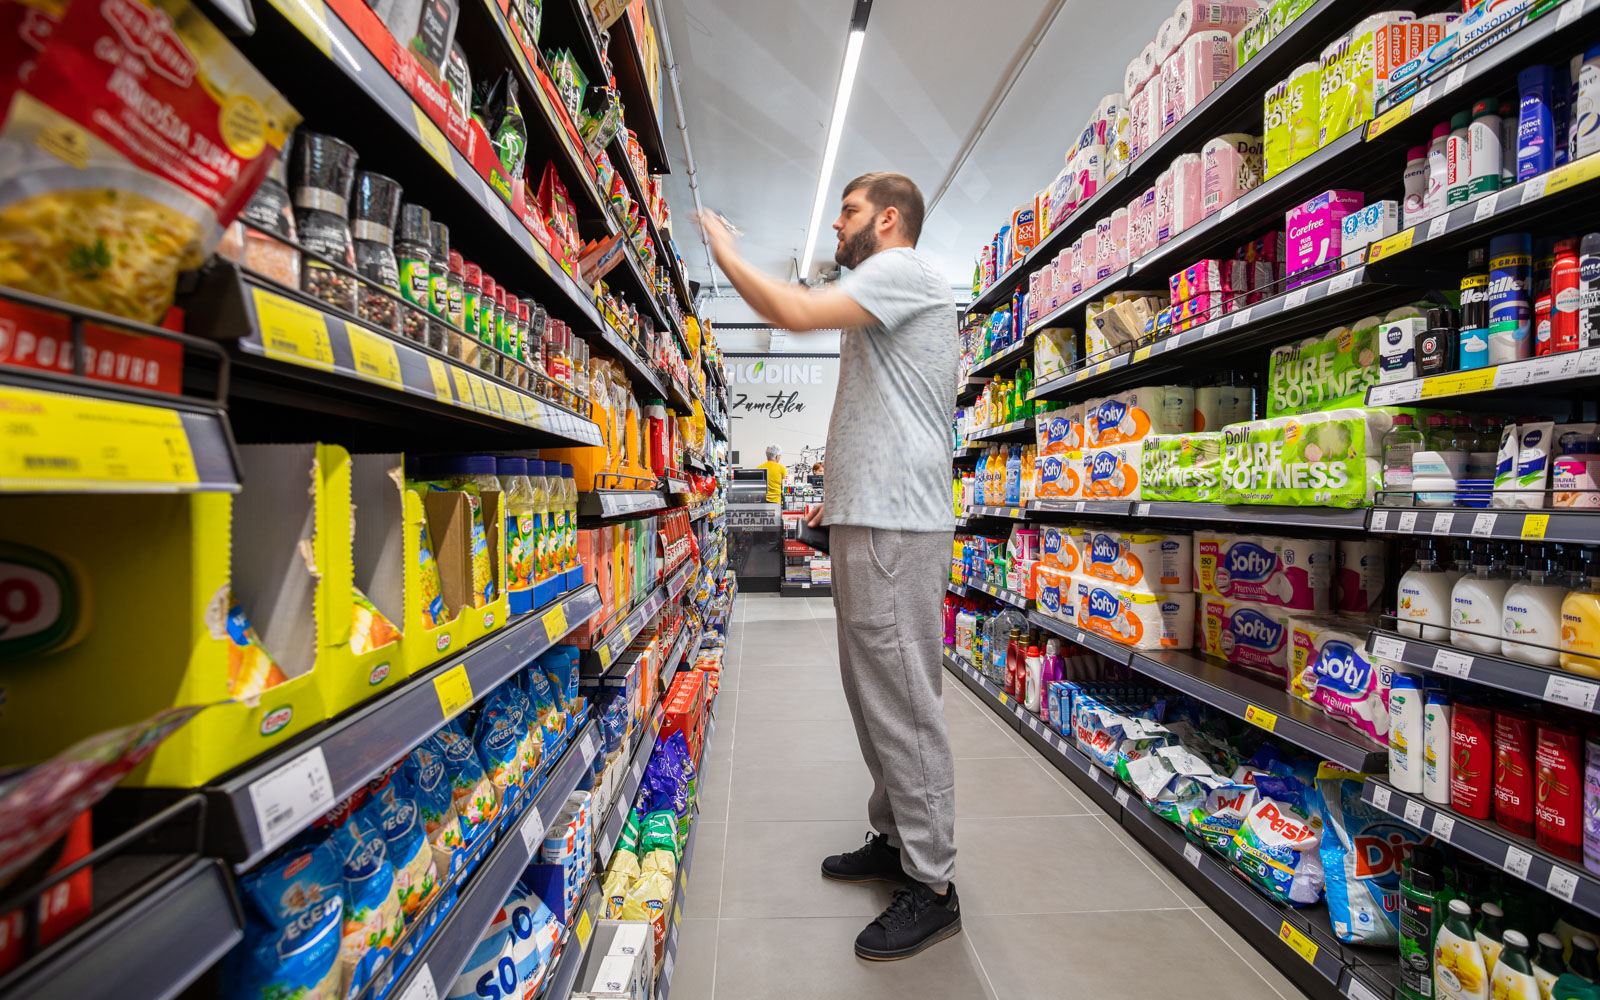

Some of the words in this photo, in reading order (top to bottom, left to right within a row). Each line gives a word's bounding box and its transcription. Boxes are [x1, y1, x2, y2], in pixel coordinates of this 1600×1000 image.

[1465, 0, 1528, 42] SENSODYNE
[1377, 30, 1385, 74] elmex
[1393, 26, 1401, 63] elmex
[1391, 62, 1420, 82] COREGA
[1289, 218, 1324, 240] Carefree
[1274, 352, 1336, 388] PURE
[1274, 366, 1380, 411] SOFTNES
[1099, 406, 1124, 424] Softy
[1050, 420, 1067, 441] Softy
[1224, 426, 1250, 446] Dolli
[1144, 439, 1160, 451] Dolli
[1224, 440, 1284, 470] PURE
[1044, 460, 1061, 478] Softy
[1094, 458, 1115, 477] Softy
[1143, 450, 1180, 470] PURE
[1142, 468, 1217, 488] SOFTNESS
[1222, 461, 1348, 490] SOFTNESS
[1045, 529, 1061, 551] Softy
[1093, 537, 1117, 561] Softy
[1231, 549, 1271, 577] Softy
[1234, 583, 1266, 595] Premium
[1402, 588, 1420, 596] esens
[1090, 594, 1118, 616] Softy
[1454, 597, 1473, 606] esens
[1506, 604, 1528, 614] esens
[1562, 613, 1582, 623] esens
[1234, 614, 1277, 646] Softy
[1239, 648, 1270, 665] Premium
[1316, 648, 1365, 691] Softy
[1381, 671, 1391, 684] 10
[1256, 802, 1315, 843] Persil
[286, 895, 342, 940] EGETA
